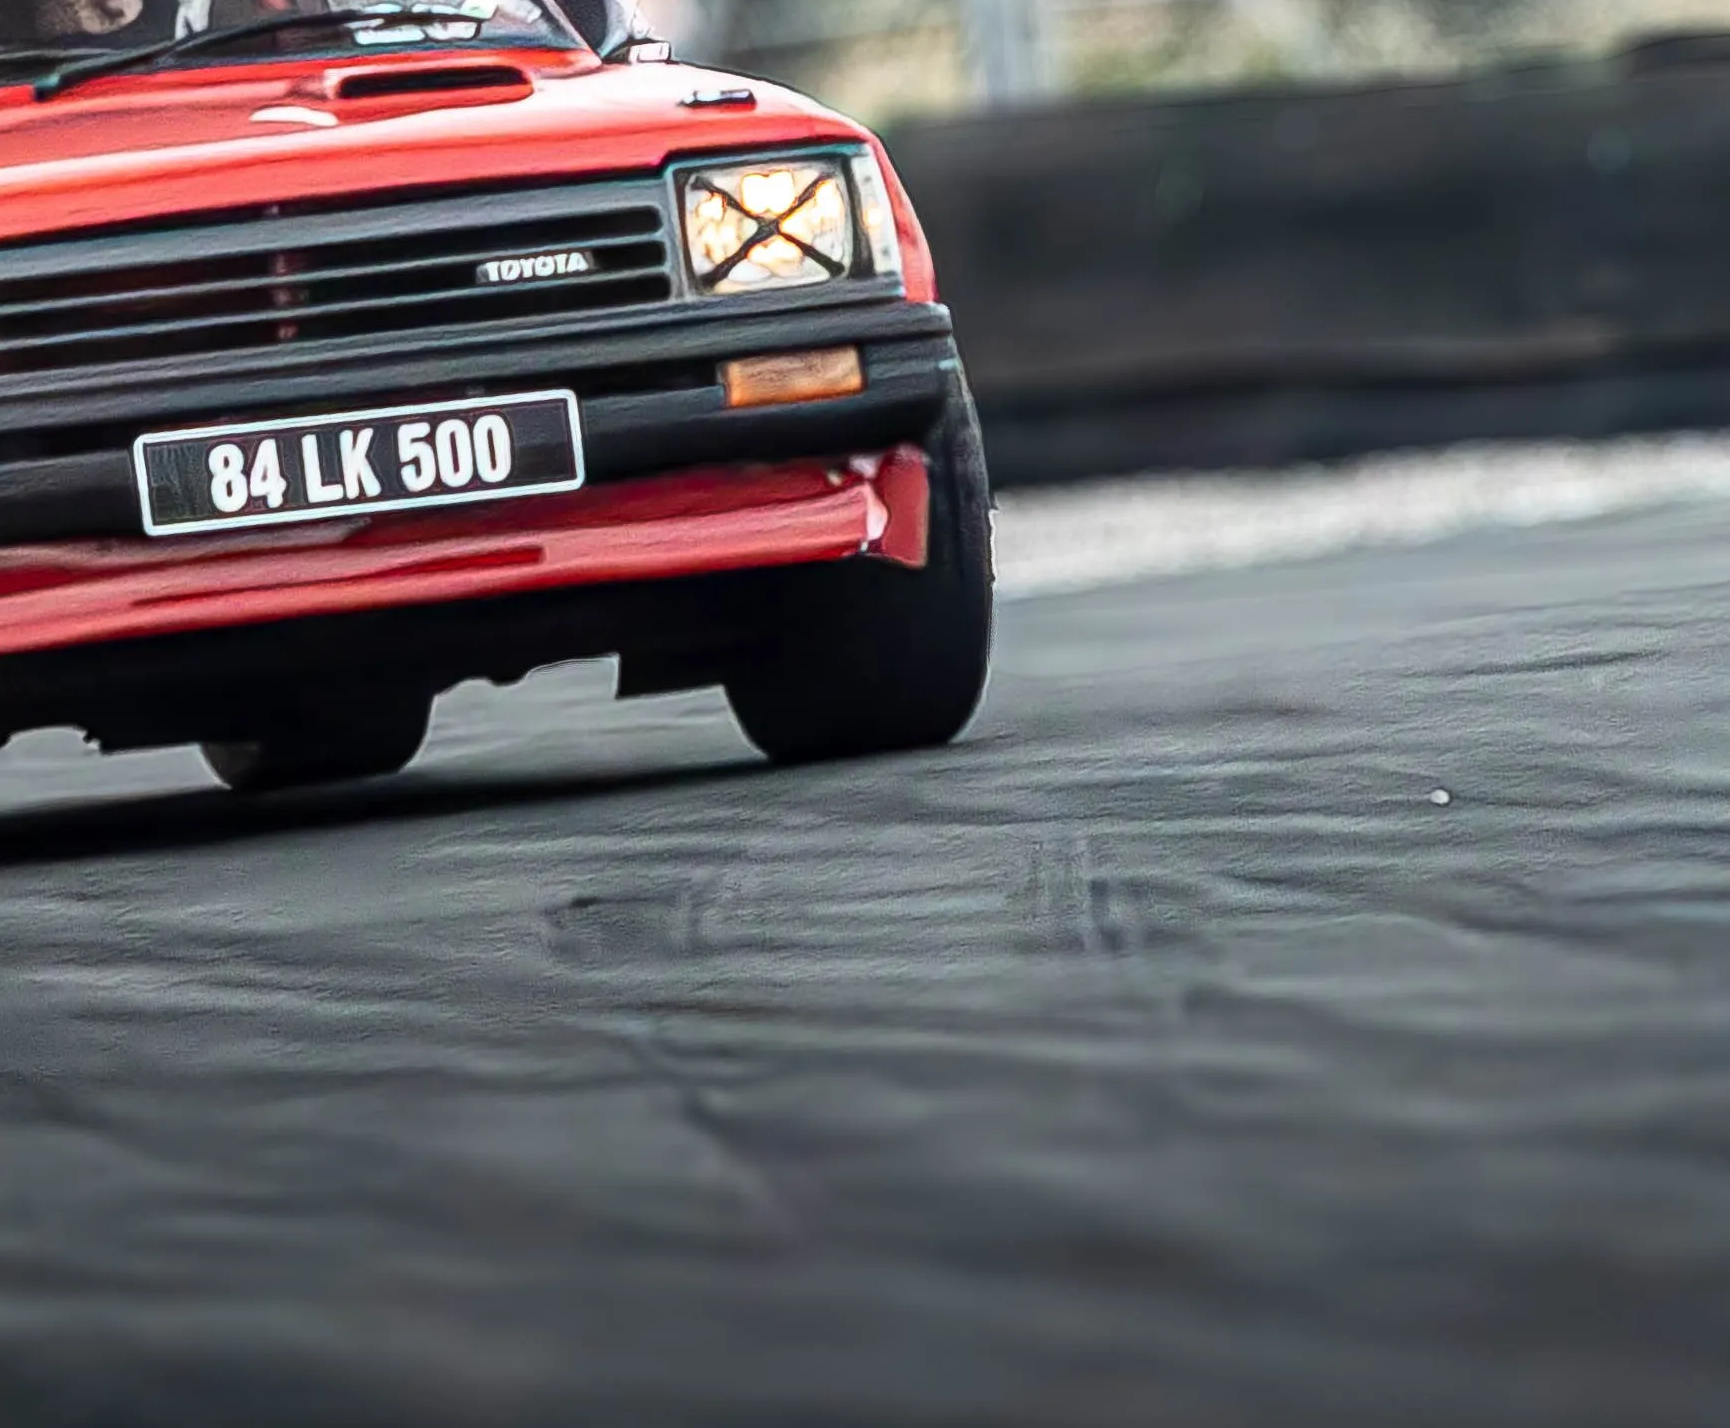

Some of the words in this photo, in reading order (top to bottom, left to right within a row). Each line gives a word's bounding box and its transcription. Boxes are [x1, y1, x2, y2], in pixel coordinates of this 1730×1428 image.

[485, 252, 589, 282] TOYOTA
[208, 438, 287, 513] 84
[301, 427, 382, 504] LK
[397, 414, 512, 492] 500
